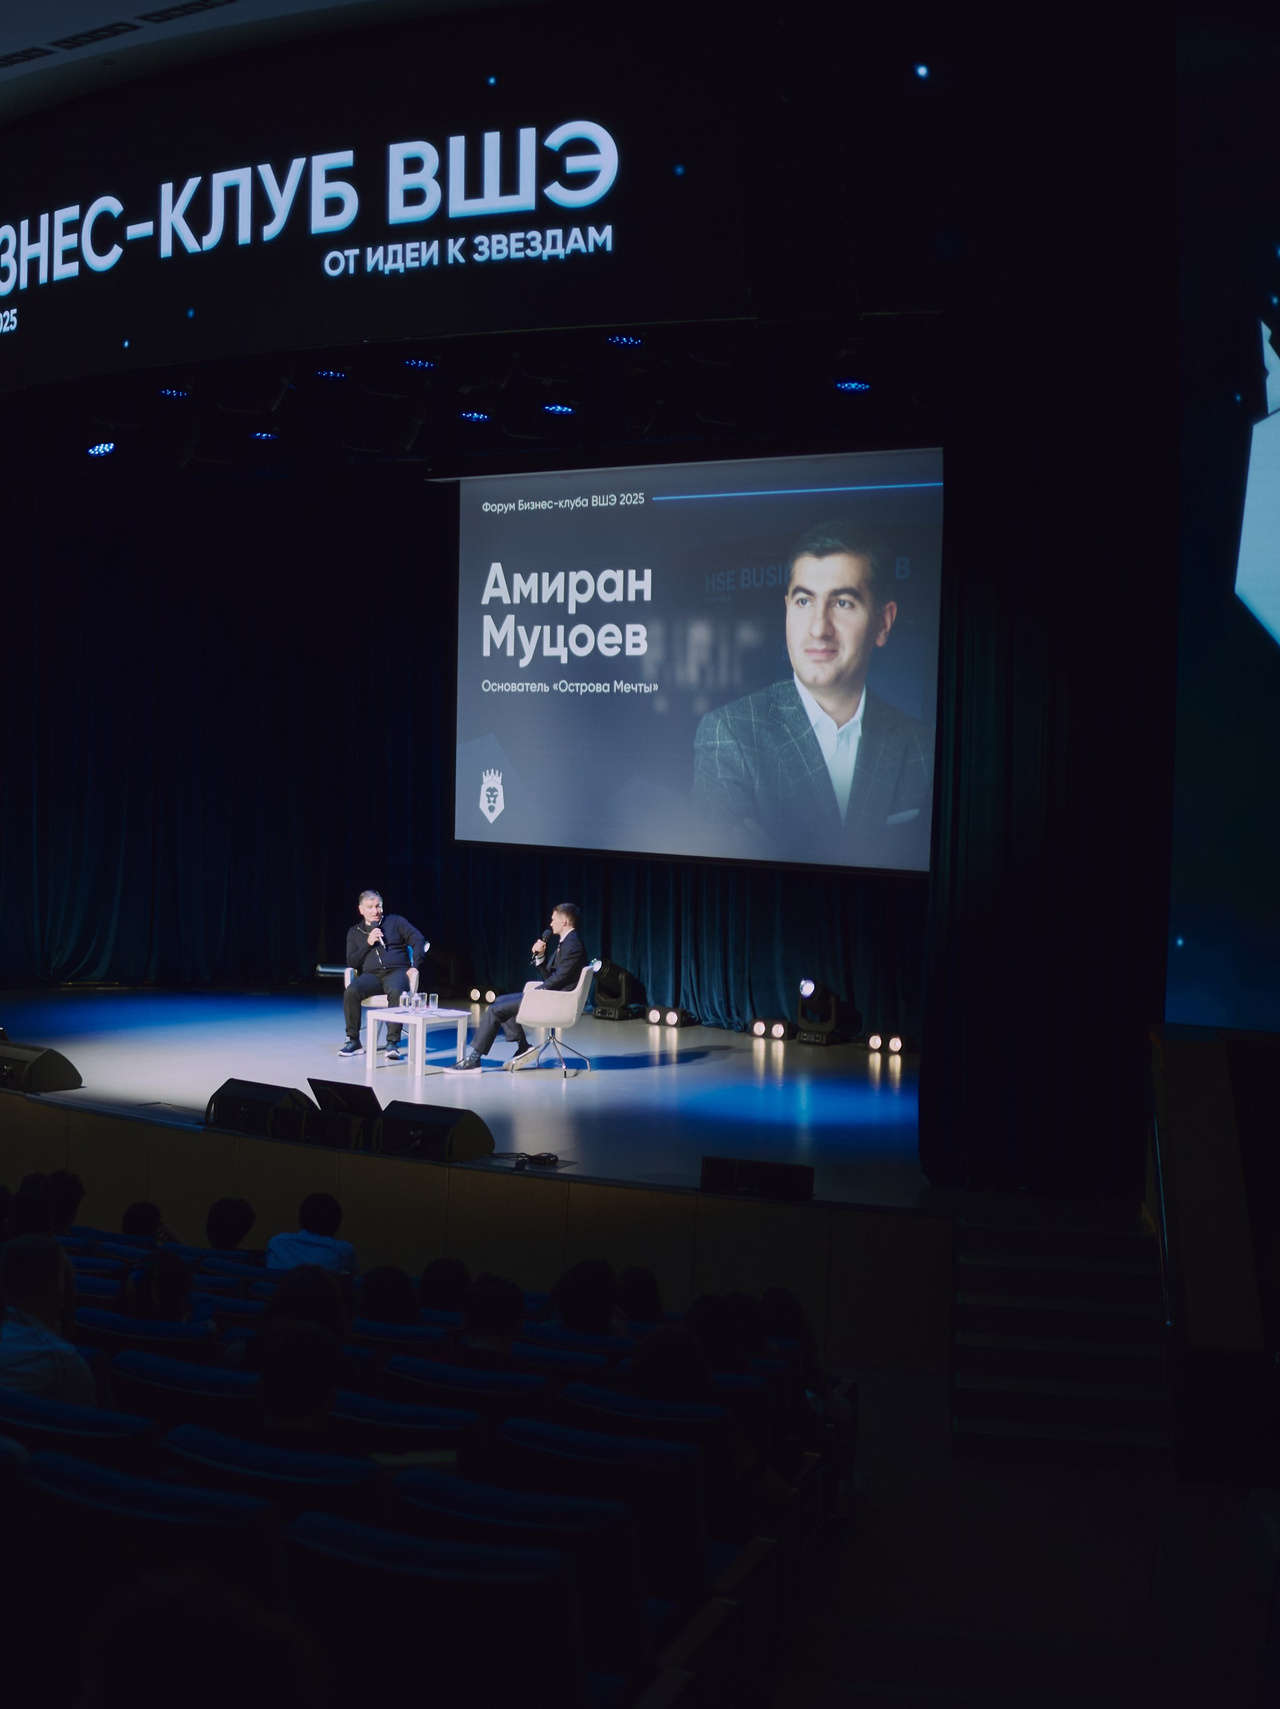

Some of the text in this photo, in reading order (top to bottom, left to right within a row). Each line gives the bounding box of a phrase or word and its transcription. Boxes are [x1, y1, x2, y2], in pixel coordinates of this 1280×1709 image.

[388, 120, 618, 225] ВШЭ
[324, 225, 612, 276] ОТ ИДЕИ К ЗВЕЗДАМ
[482, 492, 645, 515] Форум Бизнес-клуба ВШЭ 2025
[481, 562, 652, 615] Амиран
[705, 569, 736, 592] HSE
[482, 614, 648, 668] Муцоев
[482, 679, 659, 695] Основатель «Острова Мечты»
